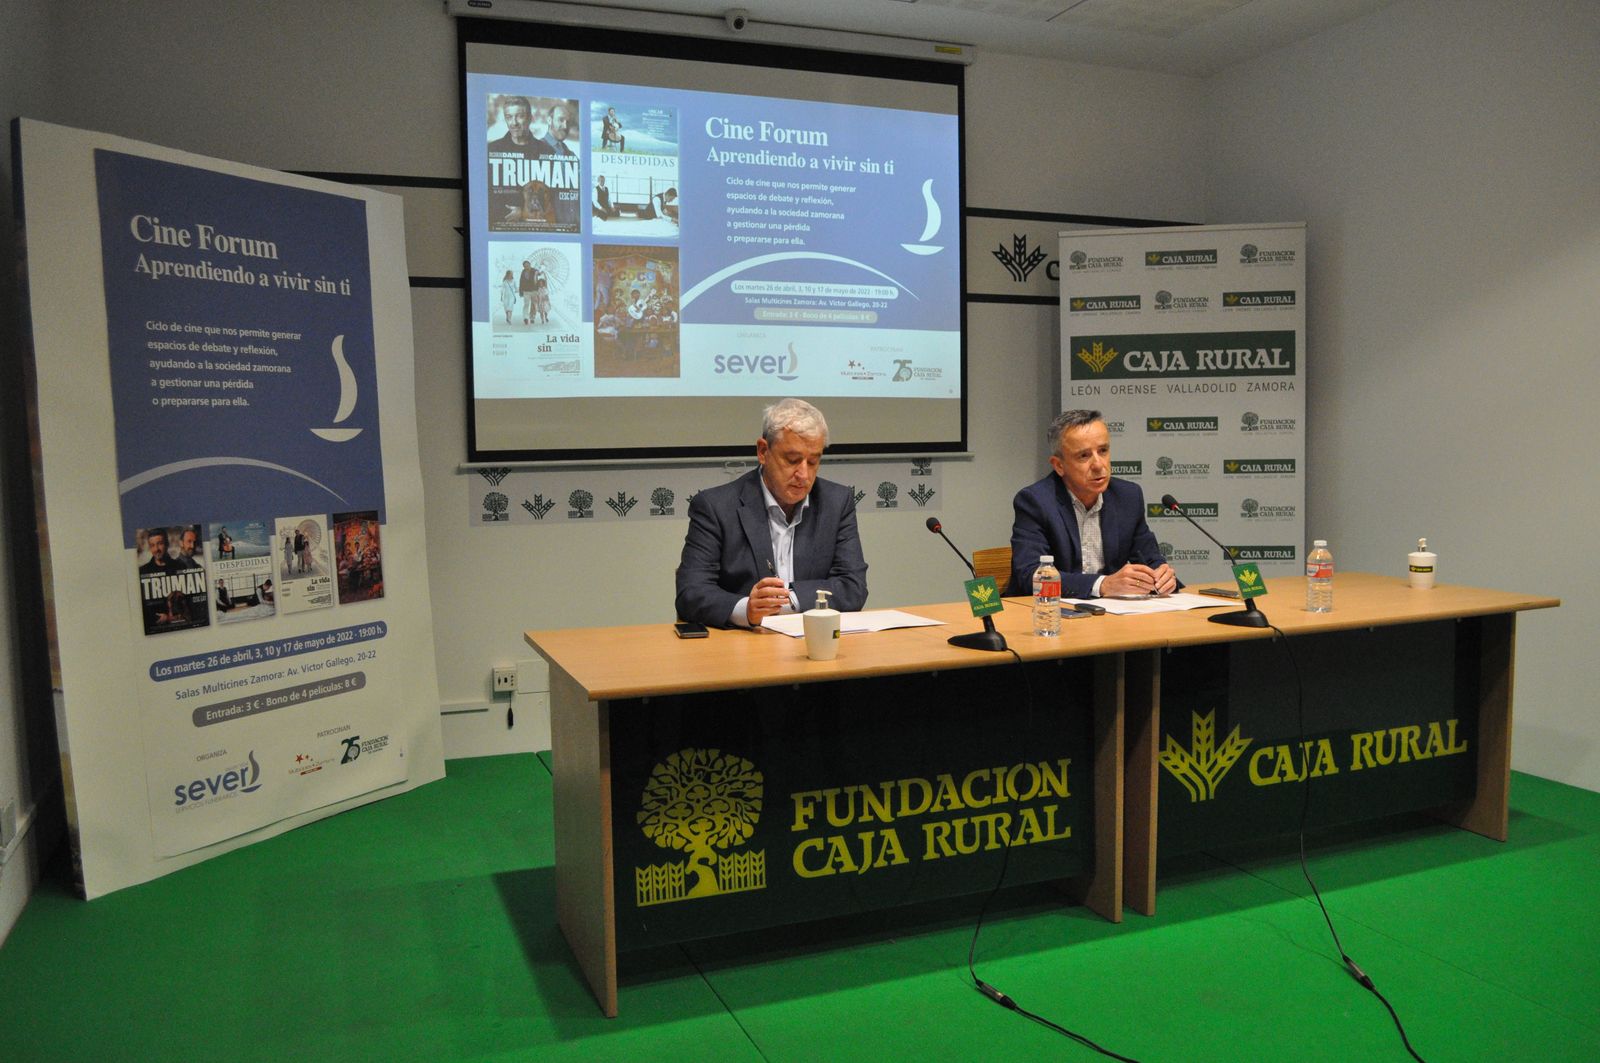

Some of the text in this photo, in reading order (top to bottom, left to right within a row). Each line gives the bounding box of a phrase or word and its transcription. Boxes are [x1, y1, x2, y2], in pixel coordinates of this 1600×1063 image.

[706, 116, 828, 146] Cine Forum
[601, 155, 675, 167] DESPEDIDAS
[706, 146, 894, 175] Aprendiendo a vivir sin ti
[489, 159, 579, 189] TRUMAN
[726, 177, 743, 185] Ciclo
[745, 178, 754, 186] de
[756, 179, 770, 187] cine
[772, 181, 785, 189] que
[801, 182, 828, 191] permite
[830, 185, 856, 193] generar
[727, 192, 756, 200] espacios
[769, 194, 793, 202] debate
[727, 206, 763, 216] ayudando
[779, 209, 809, 217] sociedad
[811, 212, 844, 220] zamorana
[733, 221, 767, 230] gestionar
[130, 215, 278, 260] Cine Forum
[734, 236, 772, 244] prepararse
[135, 253, 351, 295] Aprendiendo a vivir sin ti
[146, 321, 168, 331] Ciclo
[170, 323, 182, 332] de
[184, 323, 202, 333] cine
[204, 326, 221, 336] que
[239, 328, 270, 338] permite
[272, 332, 302, 340] generar
[547, 334, 580, 343] La vida
[147, 341, 186, 351] espacios
[189, 342, 199, 350] de
[202, 342, 231, 352] debate
[233, 346, 238, 355] y
[537, 344, 552, 353] sin
[150, 359, 195, 369] ayudando
[205, 360, 213, 369] la
[215, 361, 250, 371] sociedad
[252, 364, 291, 373] zamorana
[714, 354, 786, 374] sever
[1123, 348, 1290, 372] CAJA RURAL
[159, 378, 201, 389] gestionar
[204, 380, 220, 388] una
[1071, 382, 1295, 396] LEÓN ORENSE VALLADOLID ZAMORA
[161, 397, 209, 407] prepararse
[212, 398, 230, 407] para
[233, 397, 249, 406] ella.
[1163, 421, 1216, 430] CAJA RURAL
[1241, 464, 1294, 472] CAJA RURAL
[219, 557, 269, 570] DESPEDIDAS
[142, 572, 206, 600] TRUMAN
[156, 625, 383, 677] Los martes 26 de abril, 3, 10 y 17 de mayo de 2022 19:00 h.
[175, 689, 200, 700] Salas
[203, 679, 248, 694] Multicines
[250, 671, 285, 684] Zamora:
[287, 668, 299, 676] Av.
[326, 656, 355, 668] Gallego,
[358, 650, 376, 661] 20-22
[207, 705, 244, 720] Entrada:
[246, 703, 251, 711] 3
[254, 700, 260, 708] €
[266, 696, 287, 706] Bono
[290, 691, 300, 701] de
[351, 677, 357, 686] €
[1249, 719, 1468, 787] CAJA RURAL
[175, 767, 248, 805] sever
[791, 758, 1071, 831] FUNDACION
[793, 805, 1071, 878] CAJA RURAL
